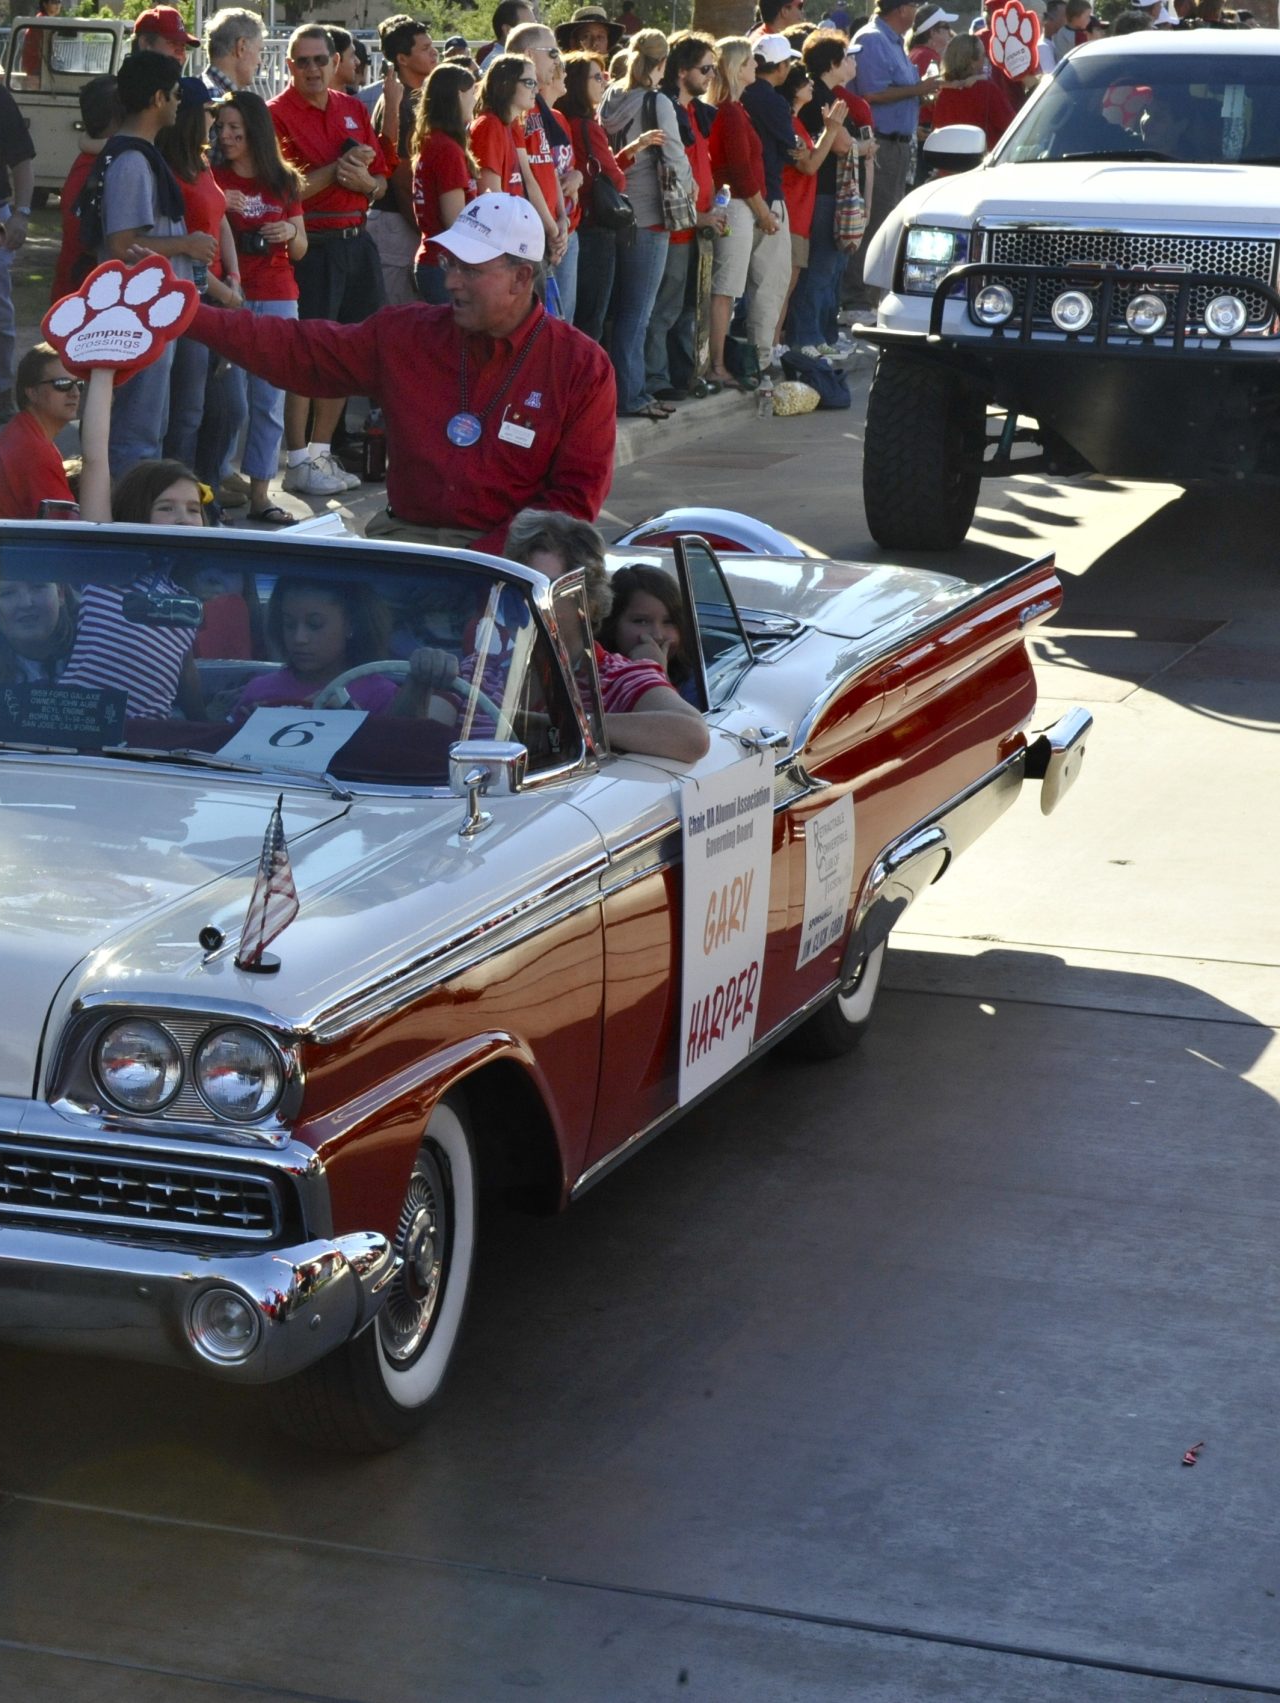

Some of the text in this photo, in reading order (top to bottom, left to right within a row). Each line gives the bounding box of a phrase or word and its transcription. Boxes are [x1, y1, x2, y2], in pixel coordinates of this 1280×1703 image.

[74, 338, 141, 352] crossings
[77, 329, 132, 342] campus
[268, 720, 326, 748] 6
[706, 806, 715, 830] UA
[715, 797, 736, 826] Alumni
[736, 786, 771, 817] Association
[706, 818, 754, 859] Governing Board
[813, 811, 845, 848] RETRACTABLE
[703, 868, 754, 956] GARY
[686, 961, 758, 1068] HARPER
